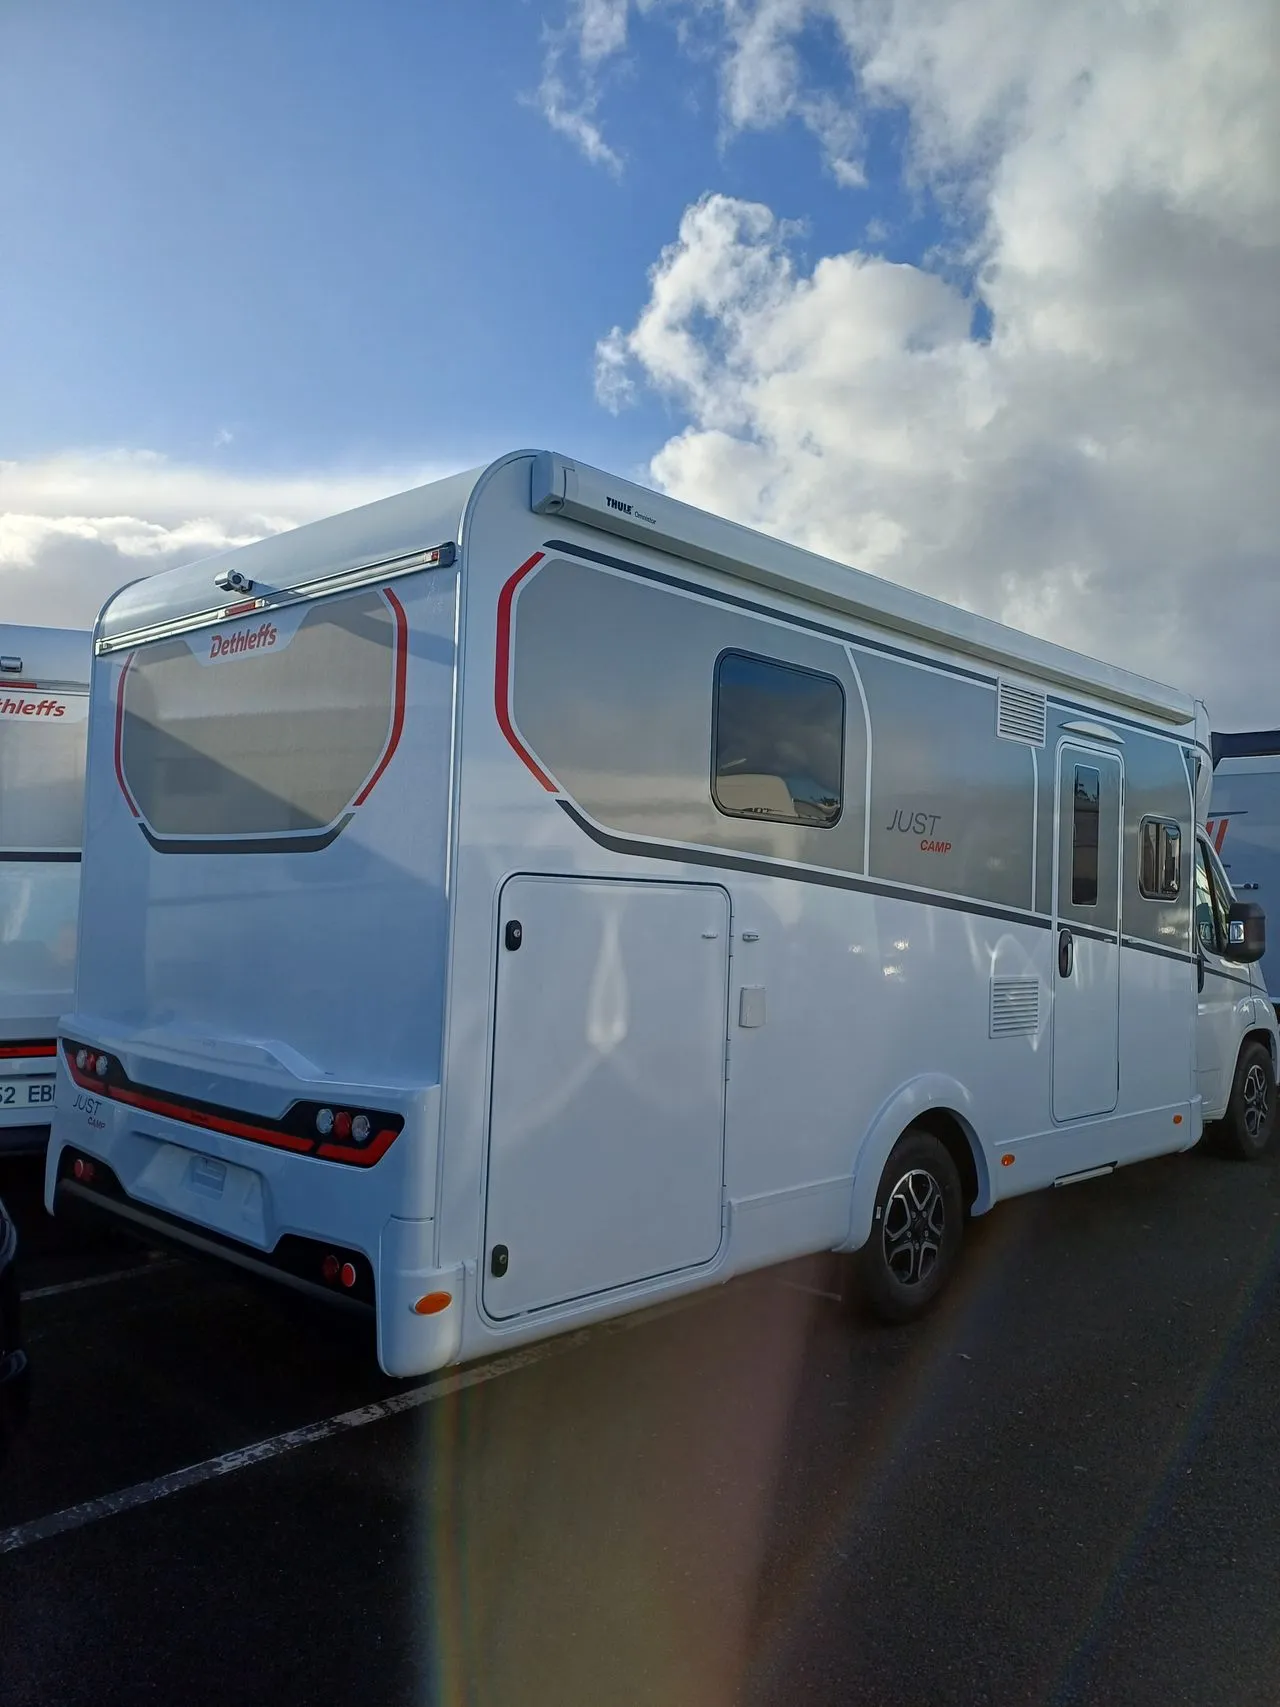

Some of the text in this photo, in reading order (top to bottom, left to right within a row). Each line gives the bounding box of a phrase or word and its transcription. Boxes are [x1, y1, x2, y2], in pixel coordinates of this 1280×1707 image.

[606, 496, 633, 515] THULE
[210, 622, 277, 658] Dethleffs
[886, 809, 942, 836] JUST
[920, 839, 952, 853] CAMP
[28, 1084, 56, 1103] EB
[73, 1094, 102, 1115] JUST
[88, 1116, 106, 1129] CAMP
